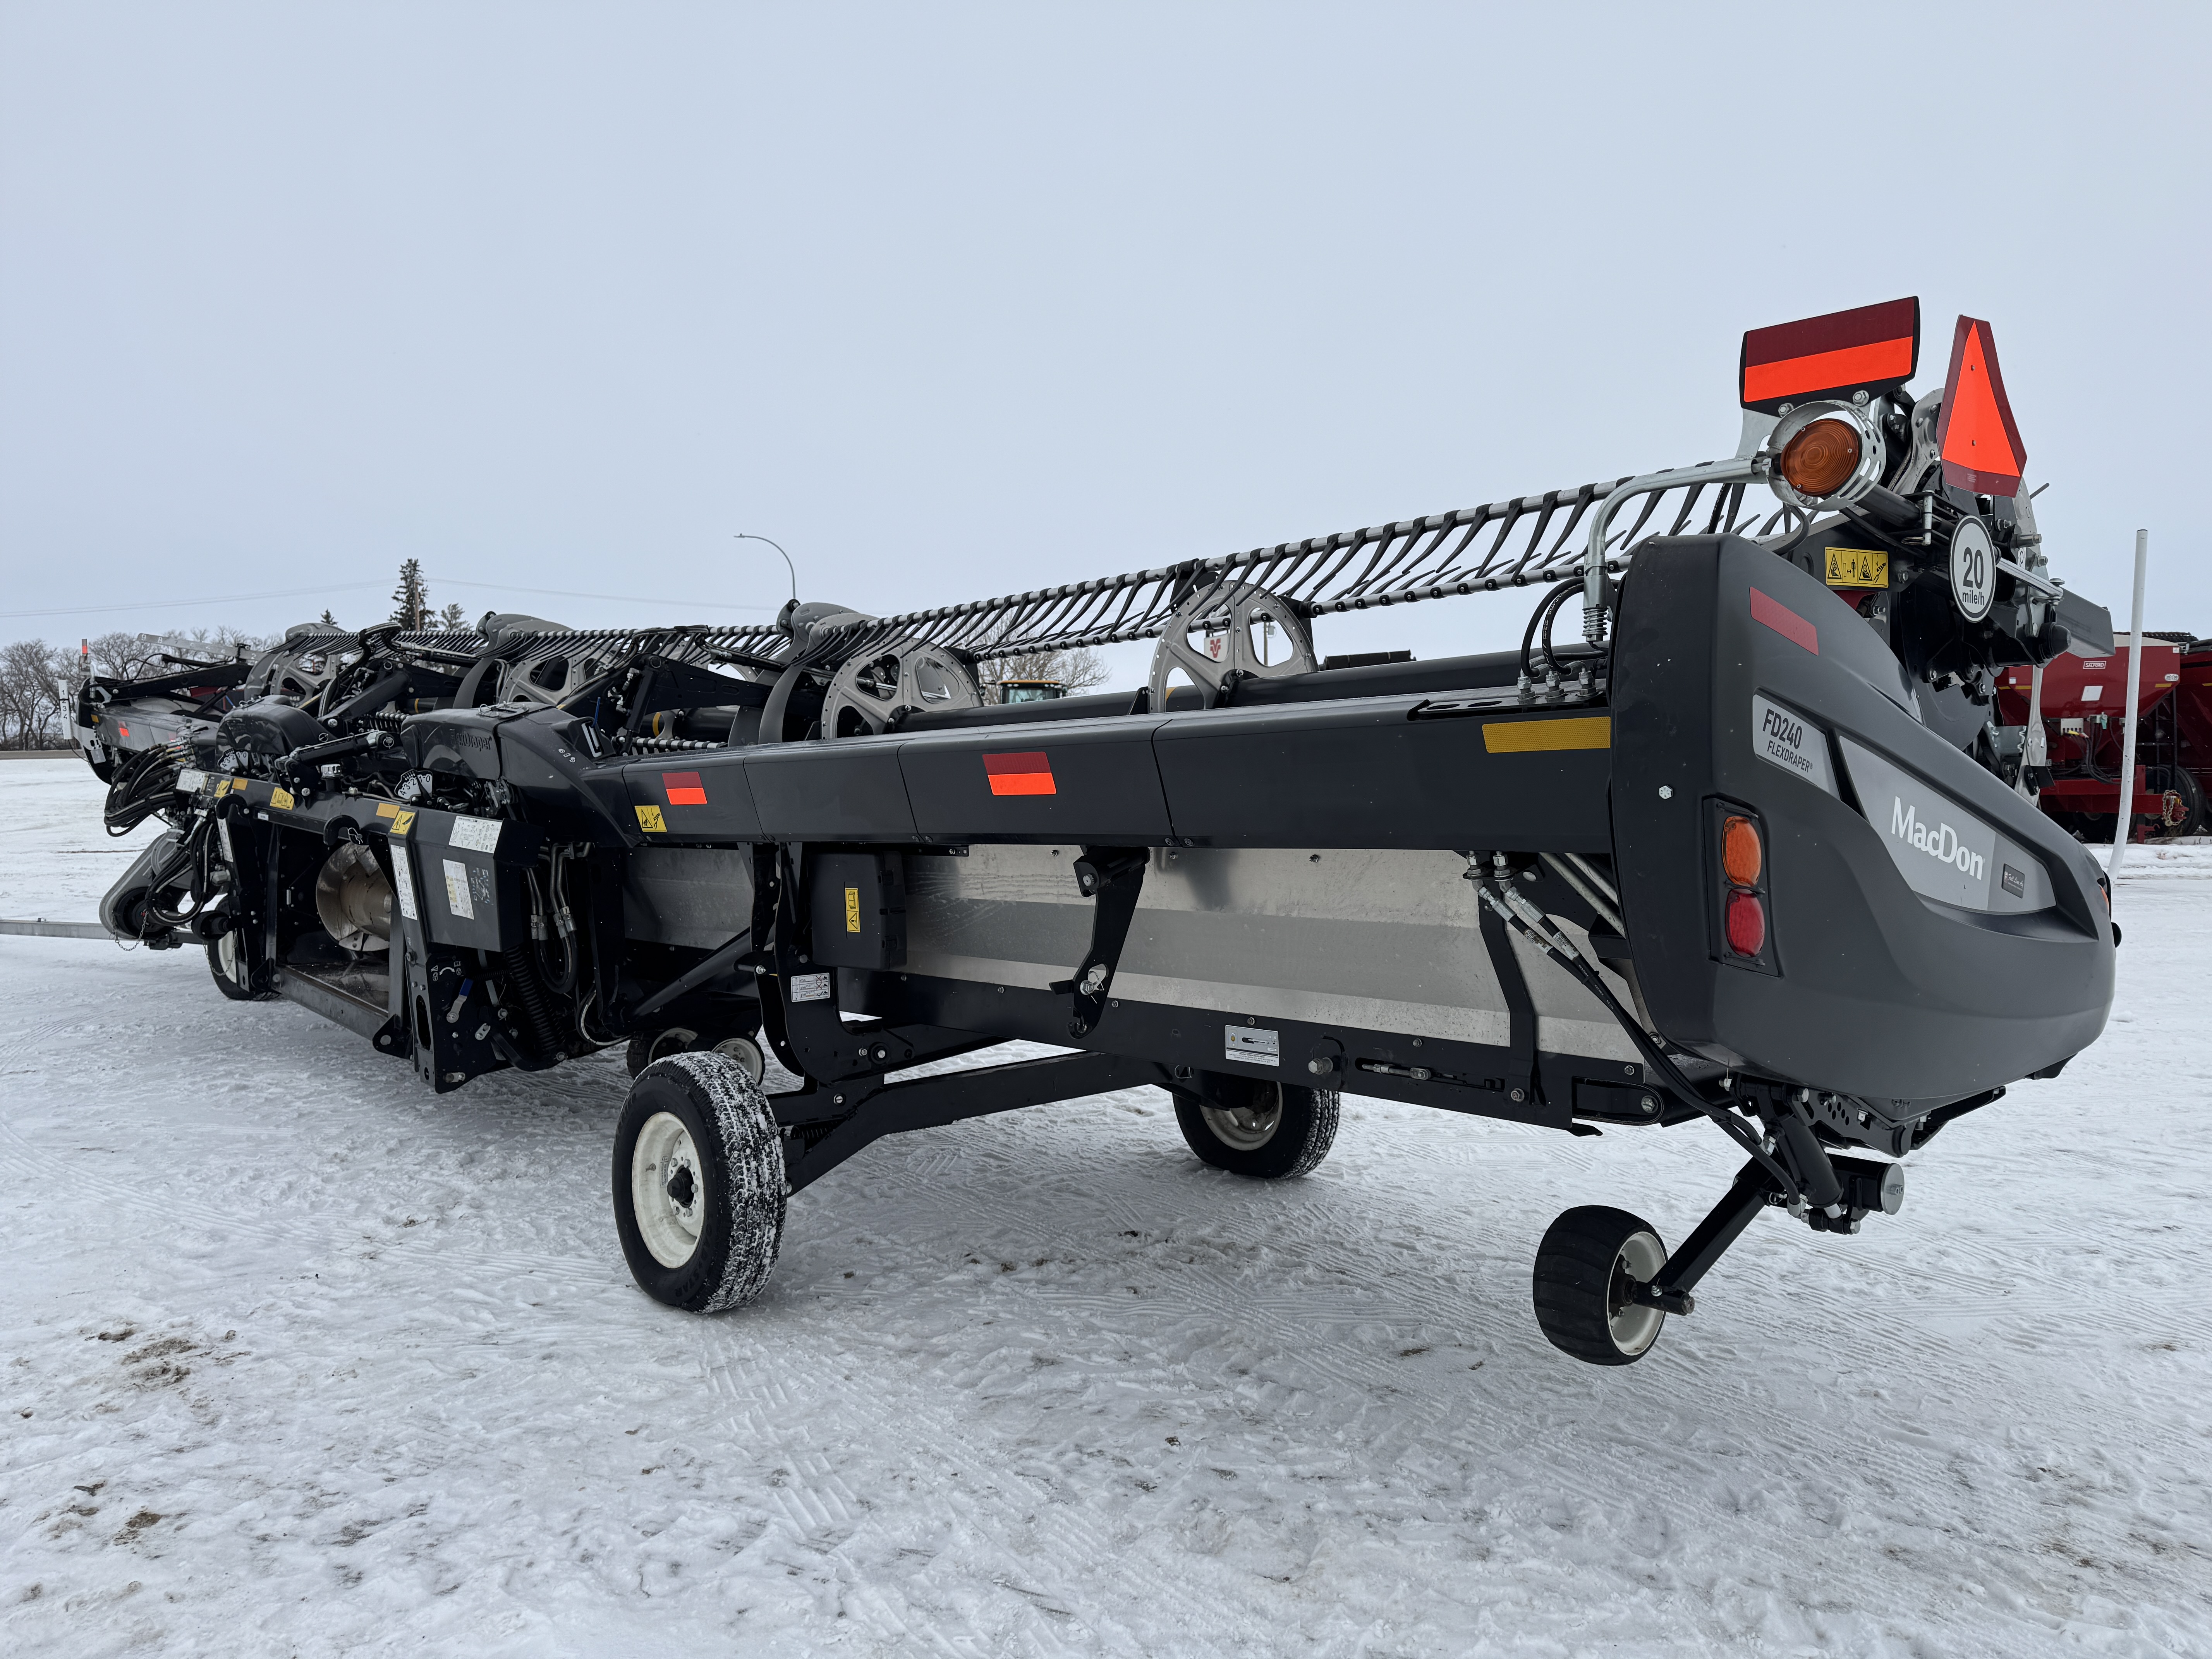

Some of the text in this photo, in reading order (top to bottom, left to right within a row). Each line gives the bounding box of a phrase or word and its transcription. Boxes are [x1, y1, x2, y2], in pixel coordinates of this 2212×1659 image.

[1963, 547, 1984, 589] 20
[1962, 590, 1985, 606] mile/h
[1763, 708, 1802, 749] FD240
[1891, 796, 1983, 880] MacDon
